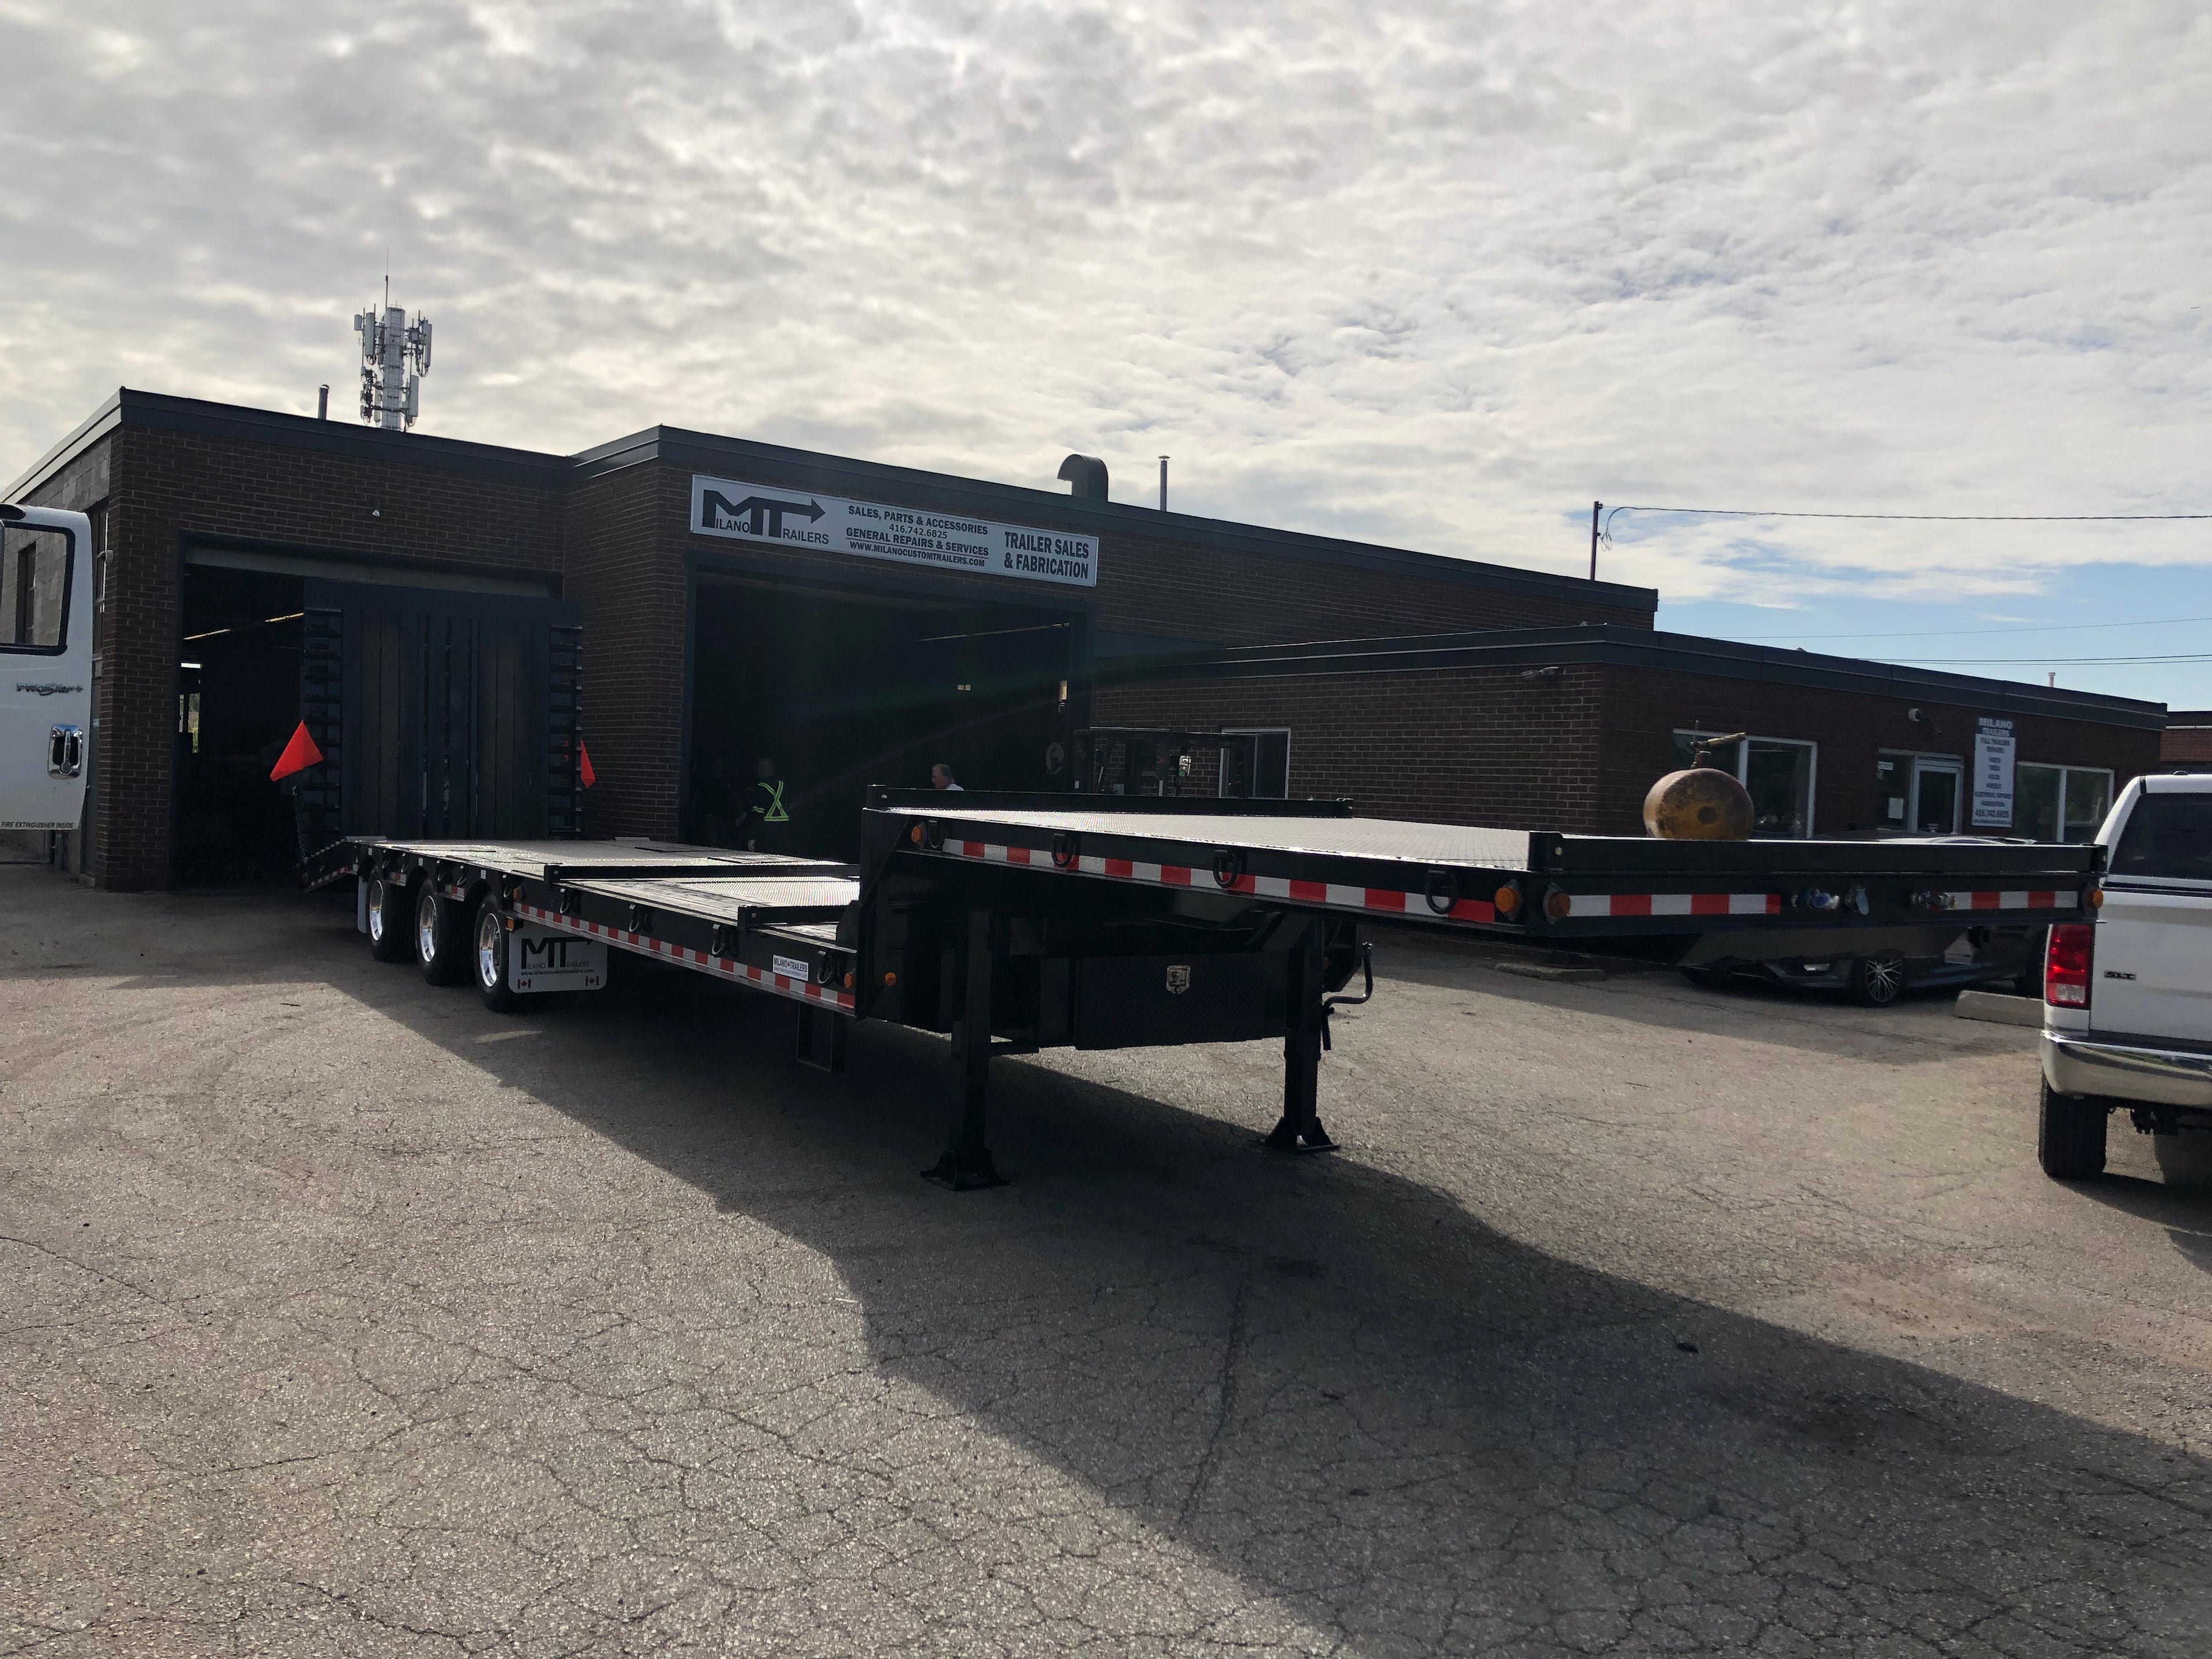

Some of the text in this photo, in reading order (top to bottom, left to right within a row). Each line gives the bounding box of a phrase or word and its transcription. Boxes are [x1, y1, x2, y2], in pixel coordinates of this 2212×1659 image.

[848, 505, 988, 535] SALES, PARTS & ACCESSORIES
[889, 524, 948, 539] 416.742.6825
[846, 527, 989, 556] GENERAL REPAIRS & SERVICES
[850, 541, 985, 567] WWW.MILANOCUSTOMTRAILERS.COM
[1004, 531, 1089, 559] TRAILER SALES
[1003, 552, 1089, 579] & FABRICATION
[1979, 718, 2012, 729] MILANO
[774, 957, 787, 968] MILANO
[790, 961, 808, 973] TRAILERS
